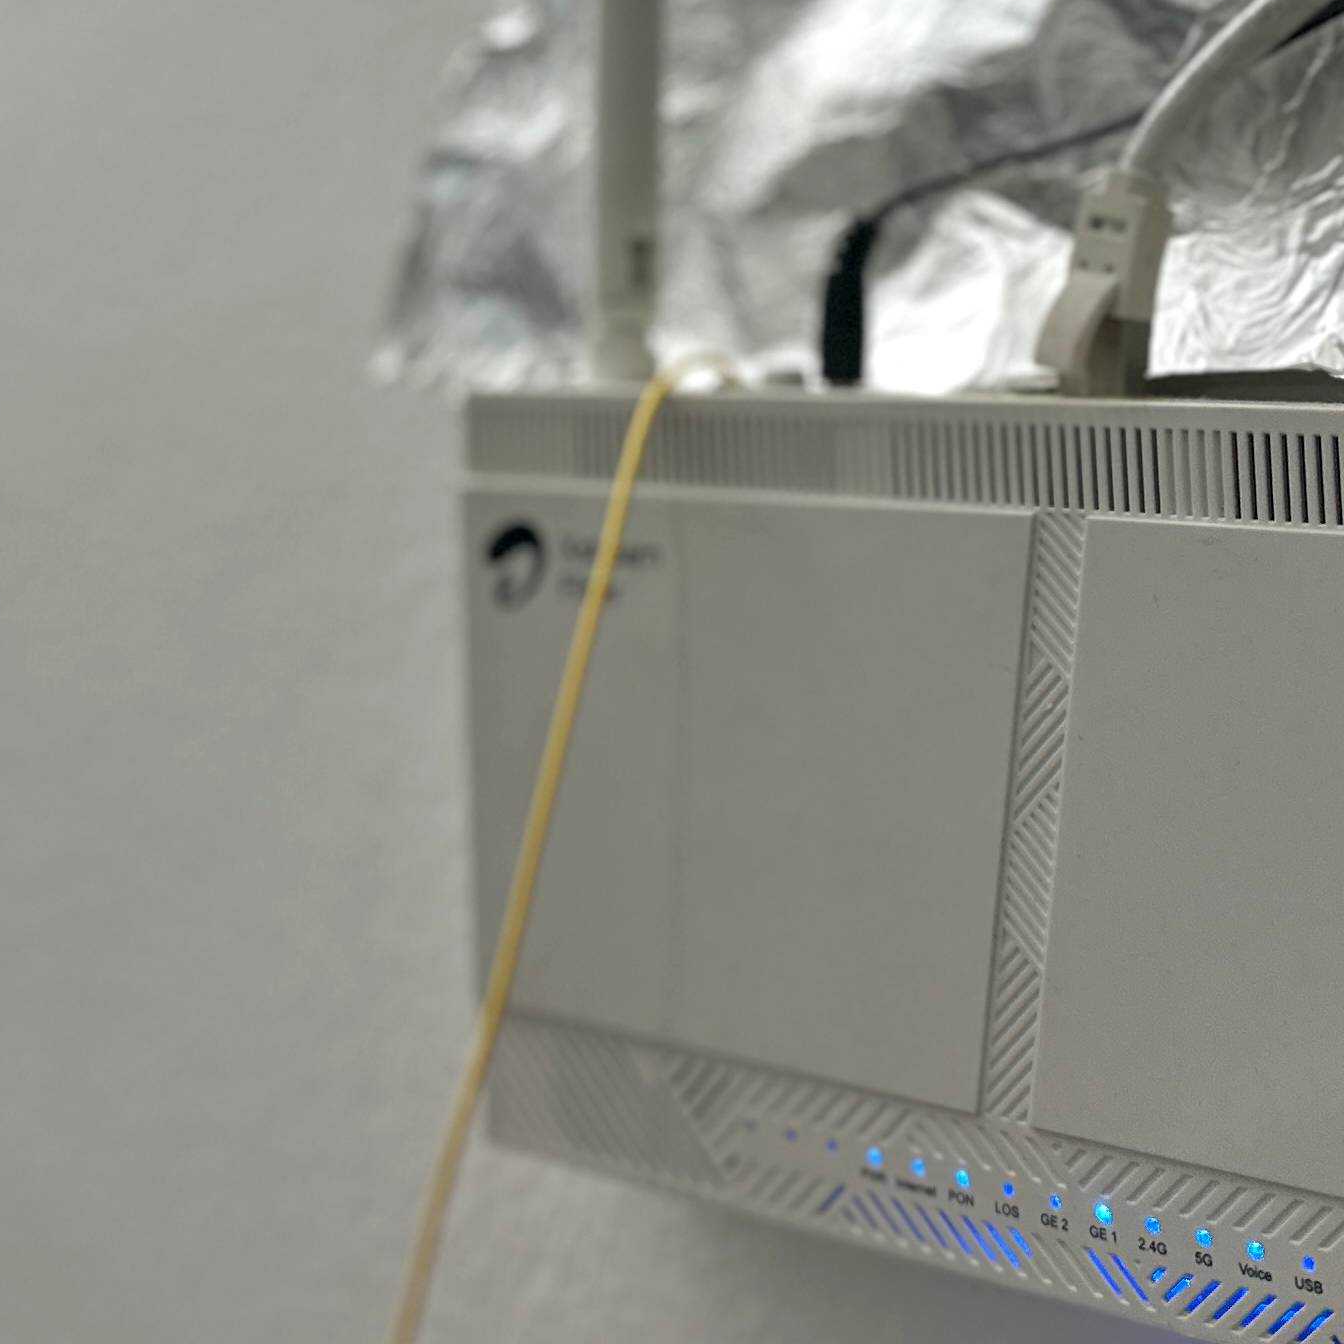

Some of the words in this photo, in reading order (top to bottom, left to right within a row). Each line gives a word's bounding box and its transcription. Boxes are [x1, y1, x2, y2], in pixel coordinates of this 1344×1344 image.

[995, 1201, 1020, 1218] LOS
[1040, 1213, 1058, 1229] GE
[1059, 1217, 1069, 1232] 2
[1089, 1225, 1108, 1242] GE
[1111, 1230, 1118, 1244] 1
[1138, 1237, 1168, 1256] 2.4G
[1194, 1251, 1213, 1268] 5G
[1238, 1262, 1273, 1282] Voice
[1294, 1275, 1324, 1295] USB
